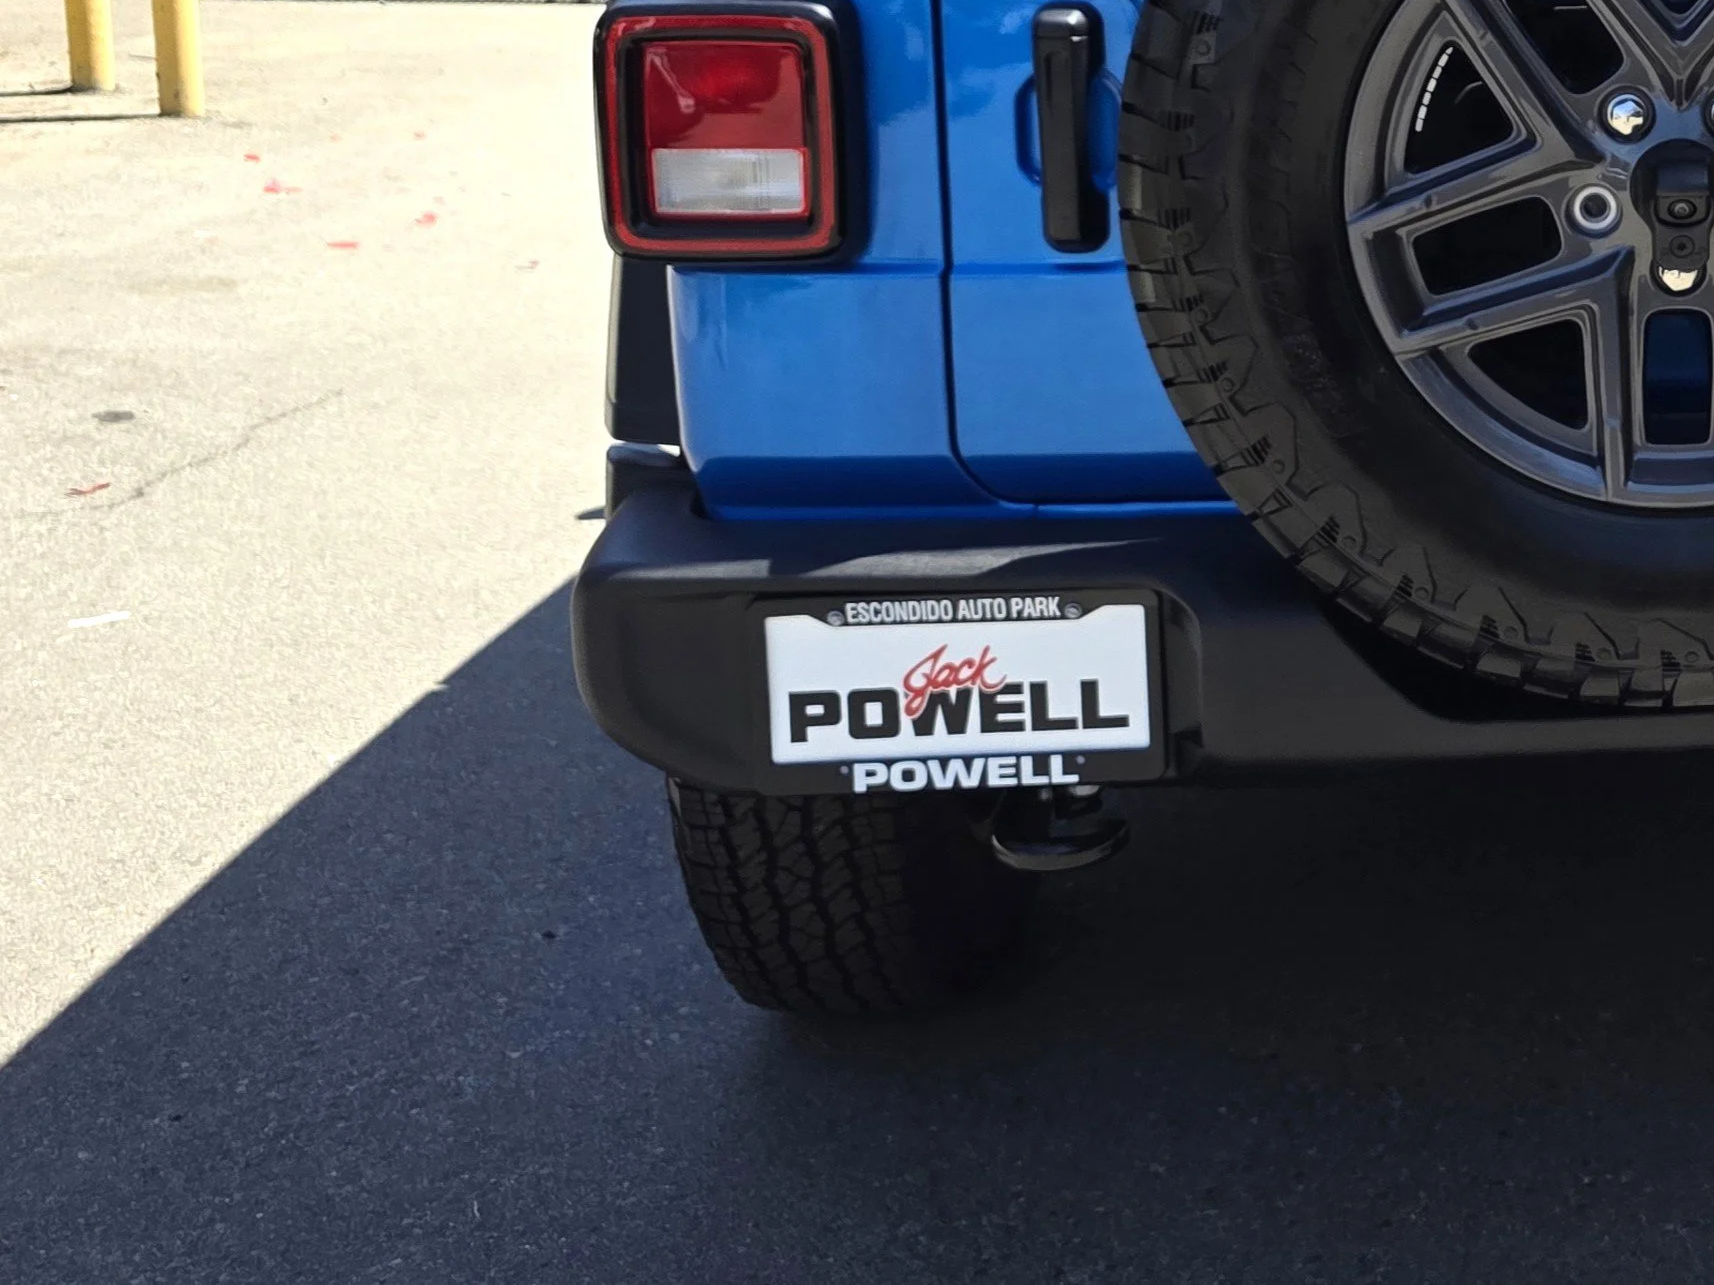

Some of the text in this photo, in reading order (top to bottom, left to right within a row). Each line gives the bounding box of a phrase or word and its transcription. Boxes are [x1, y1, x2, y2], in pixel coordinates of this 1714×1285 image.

[844, 596, 1063, 625] ESCONDIDO AUTO PARK
[902, 644, 1007, 719] Jack
[787, 679, 1131, 744] POWELL
[852, 755, 1080, 794] POWELL
